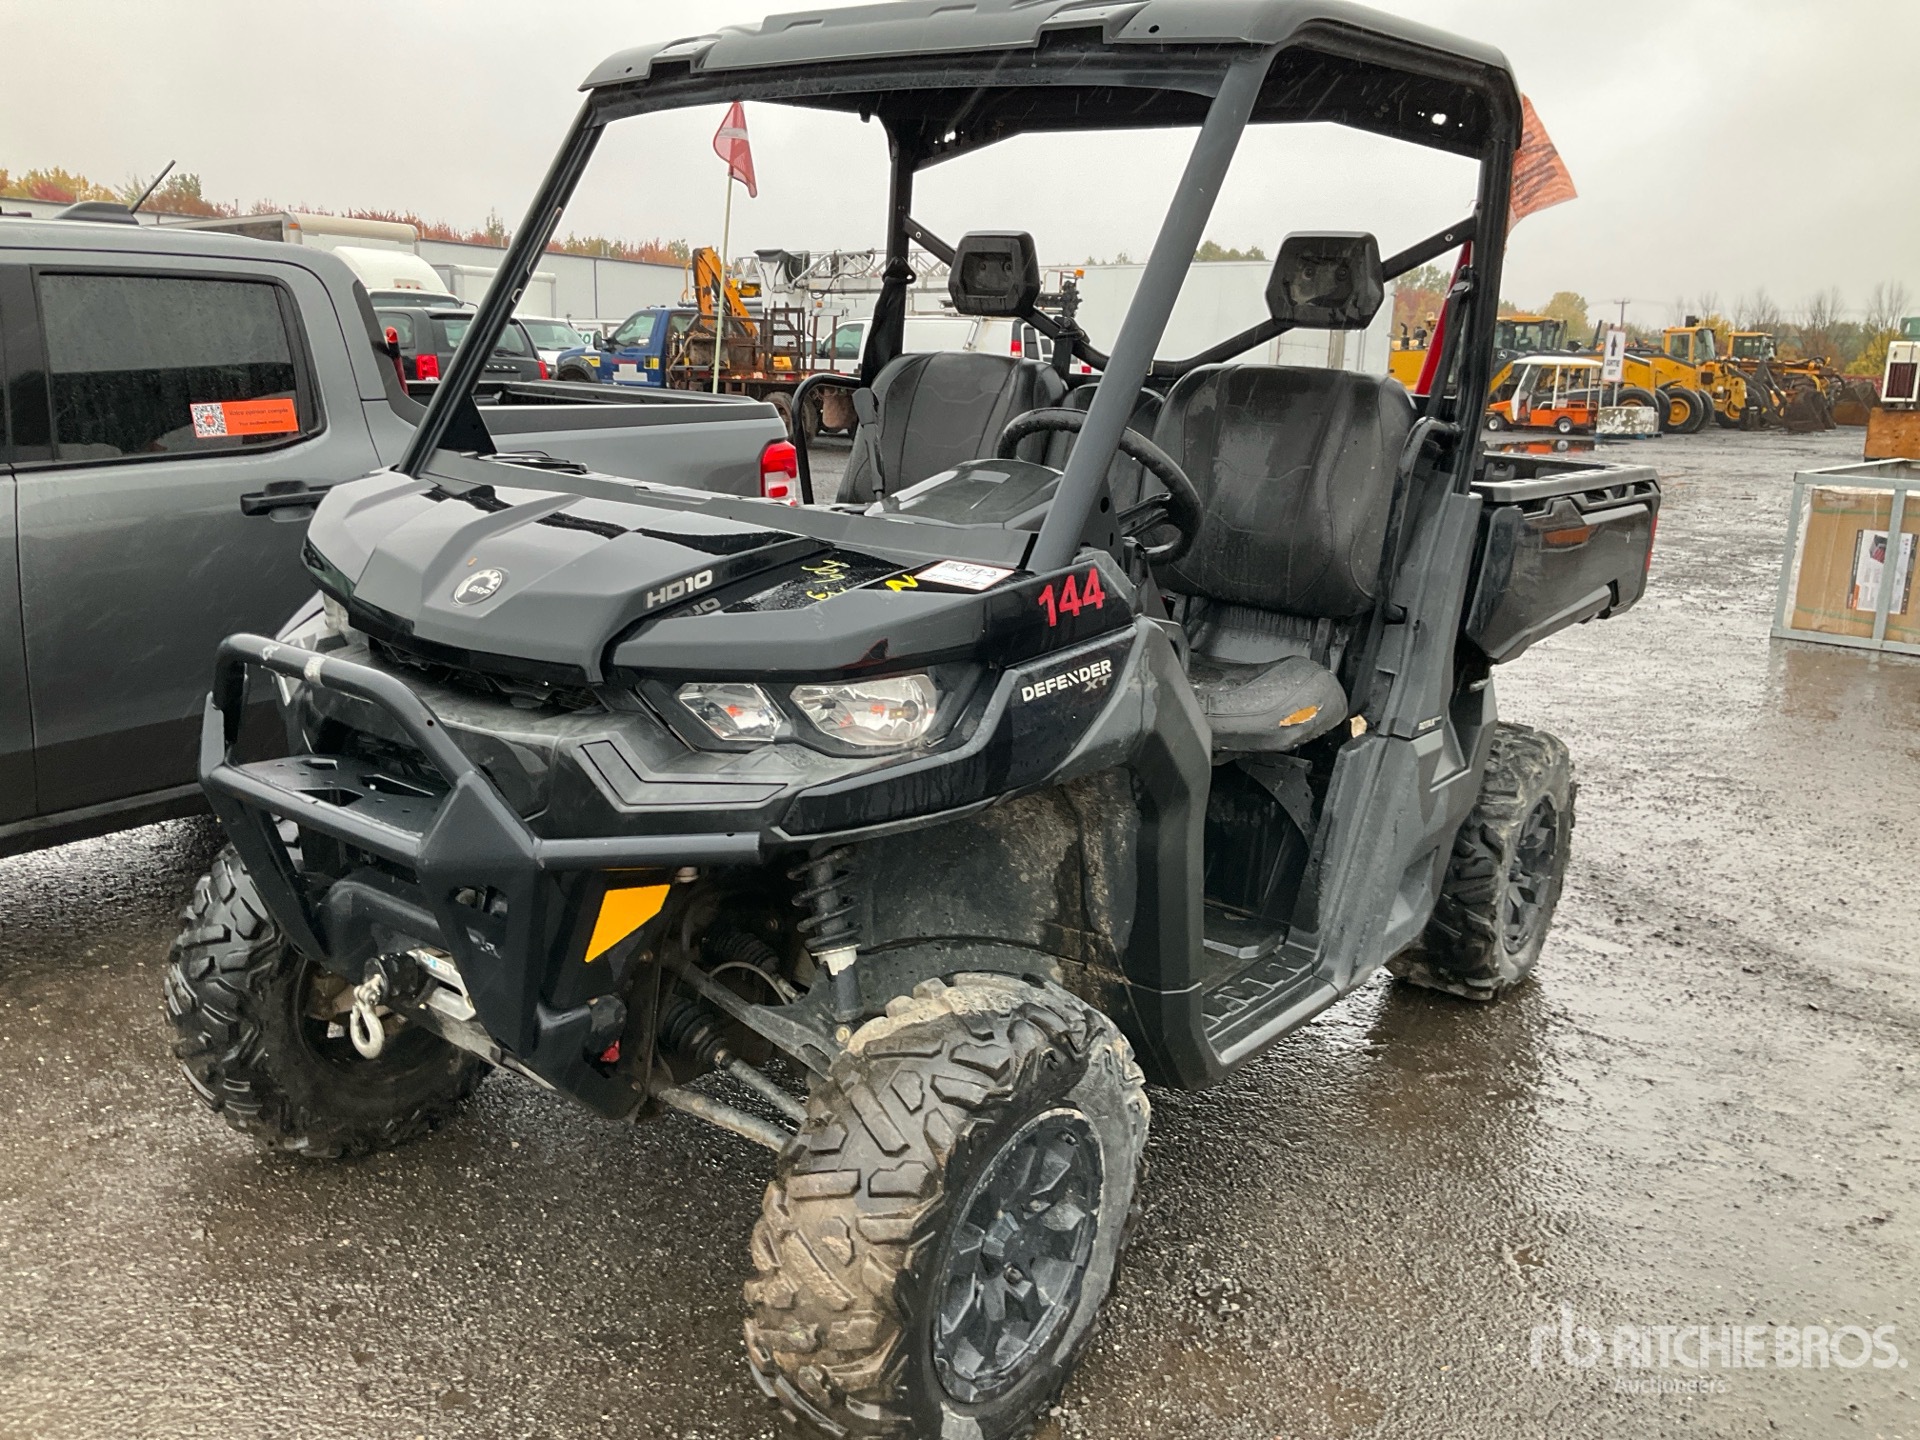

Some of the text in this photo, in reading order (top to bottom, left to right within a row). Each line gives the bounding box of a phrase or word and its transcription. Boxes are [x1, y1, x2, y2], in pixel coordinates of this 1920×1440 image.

[468, 585, 491, 595] BRP
[646, 569, 713, 609] HD10
[1038, 566, 1106, 627] 144
[1021, 659, 1112, 703] DEFENDER
[1084, 674, 1112, 693] XT
